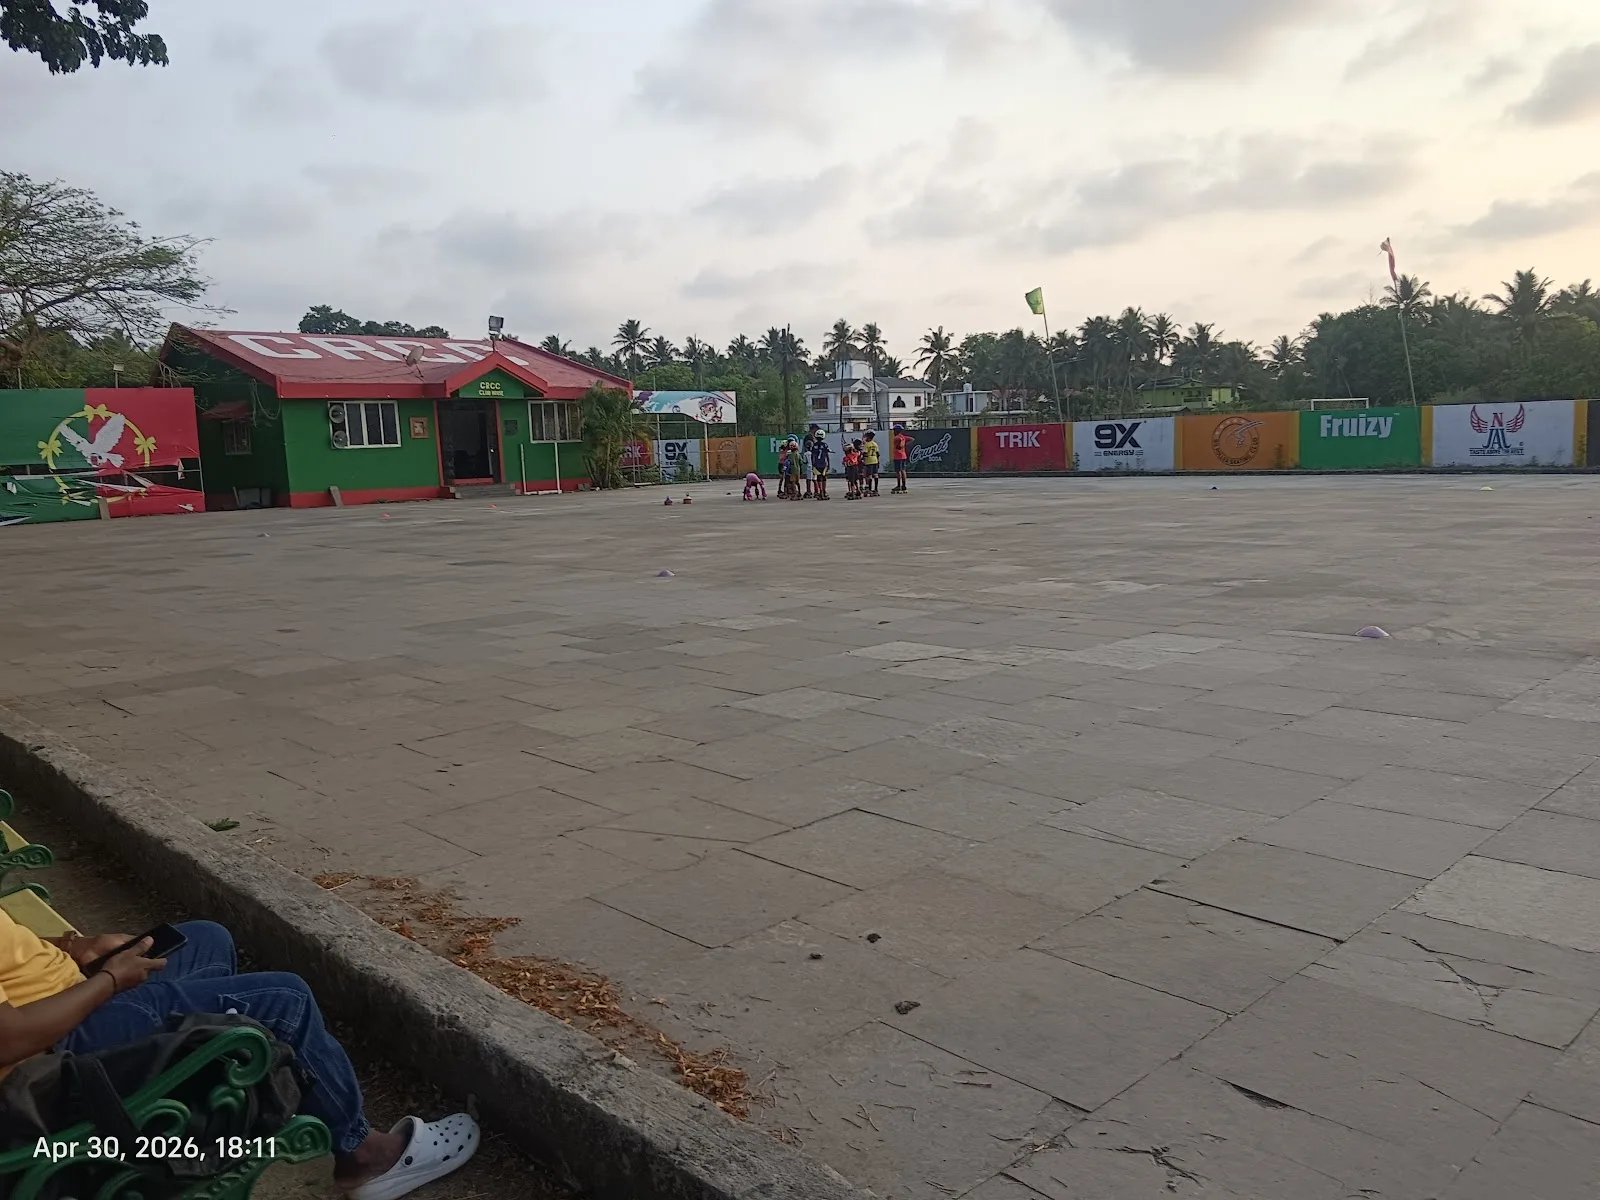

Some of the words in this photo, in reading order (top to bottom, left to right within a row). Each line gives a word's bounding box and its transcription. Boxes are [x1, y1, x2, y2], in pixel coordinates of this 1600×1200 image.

[227, 334, 530, 366] CRCC
[480, 381, 501, 390] CRCC
[1094, 421, 1143, 449] 9X
[1320, 413, 1393, 439] Fruizy
[995, 430, 1041, 448] TRIK
[664, 442, 688, 461] 9X
[1102, 449, 1135, 457] ENERGY
